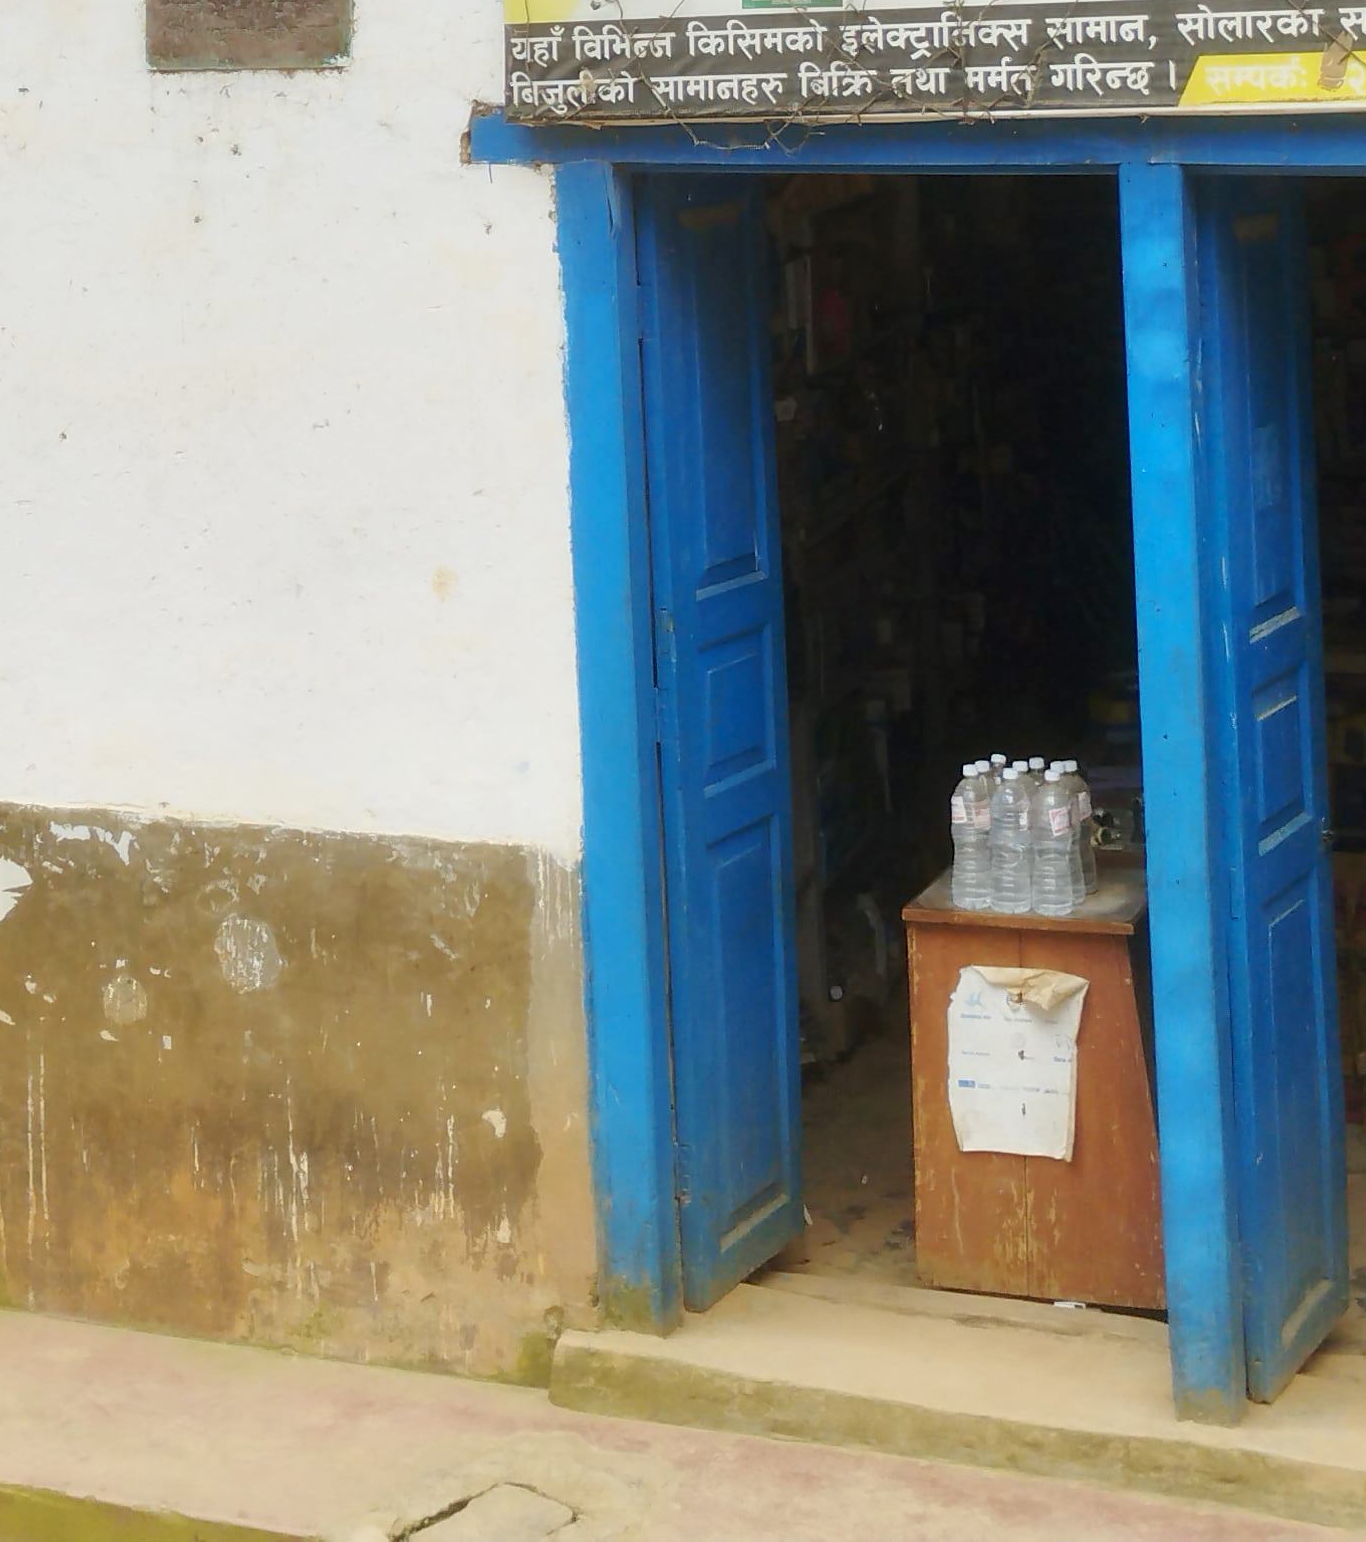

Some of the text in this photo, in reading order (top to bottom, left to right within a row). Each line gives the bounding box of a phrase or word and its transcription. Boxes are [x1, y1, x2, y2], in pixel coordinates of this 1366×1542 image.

[511, 24, 565, 67] यहाँ
[685, 19, 828, 60] किसिमको
[1045, 14, 1158, 52] सामान,
[1176, 0, 1325, 43] सोलारका
[649, 71, 788, 108] सामानहरु
[889, 66, 951, 99] तथा
[964, 56, 1038, 96] मर्मत
[1049, 52, 1155, 97] गरिन्छ
